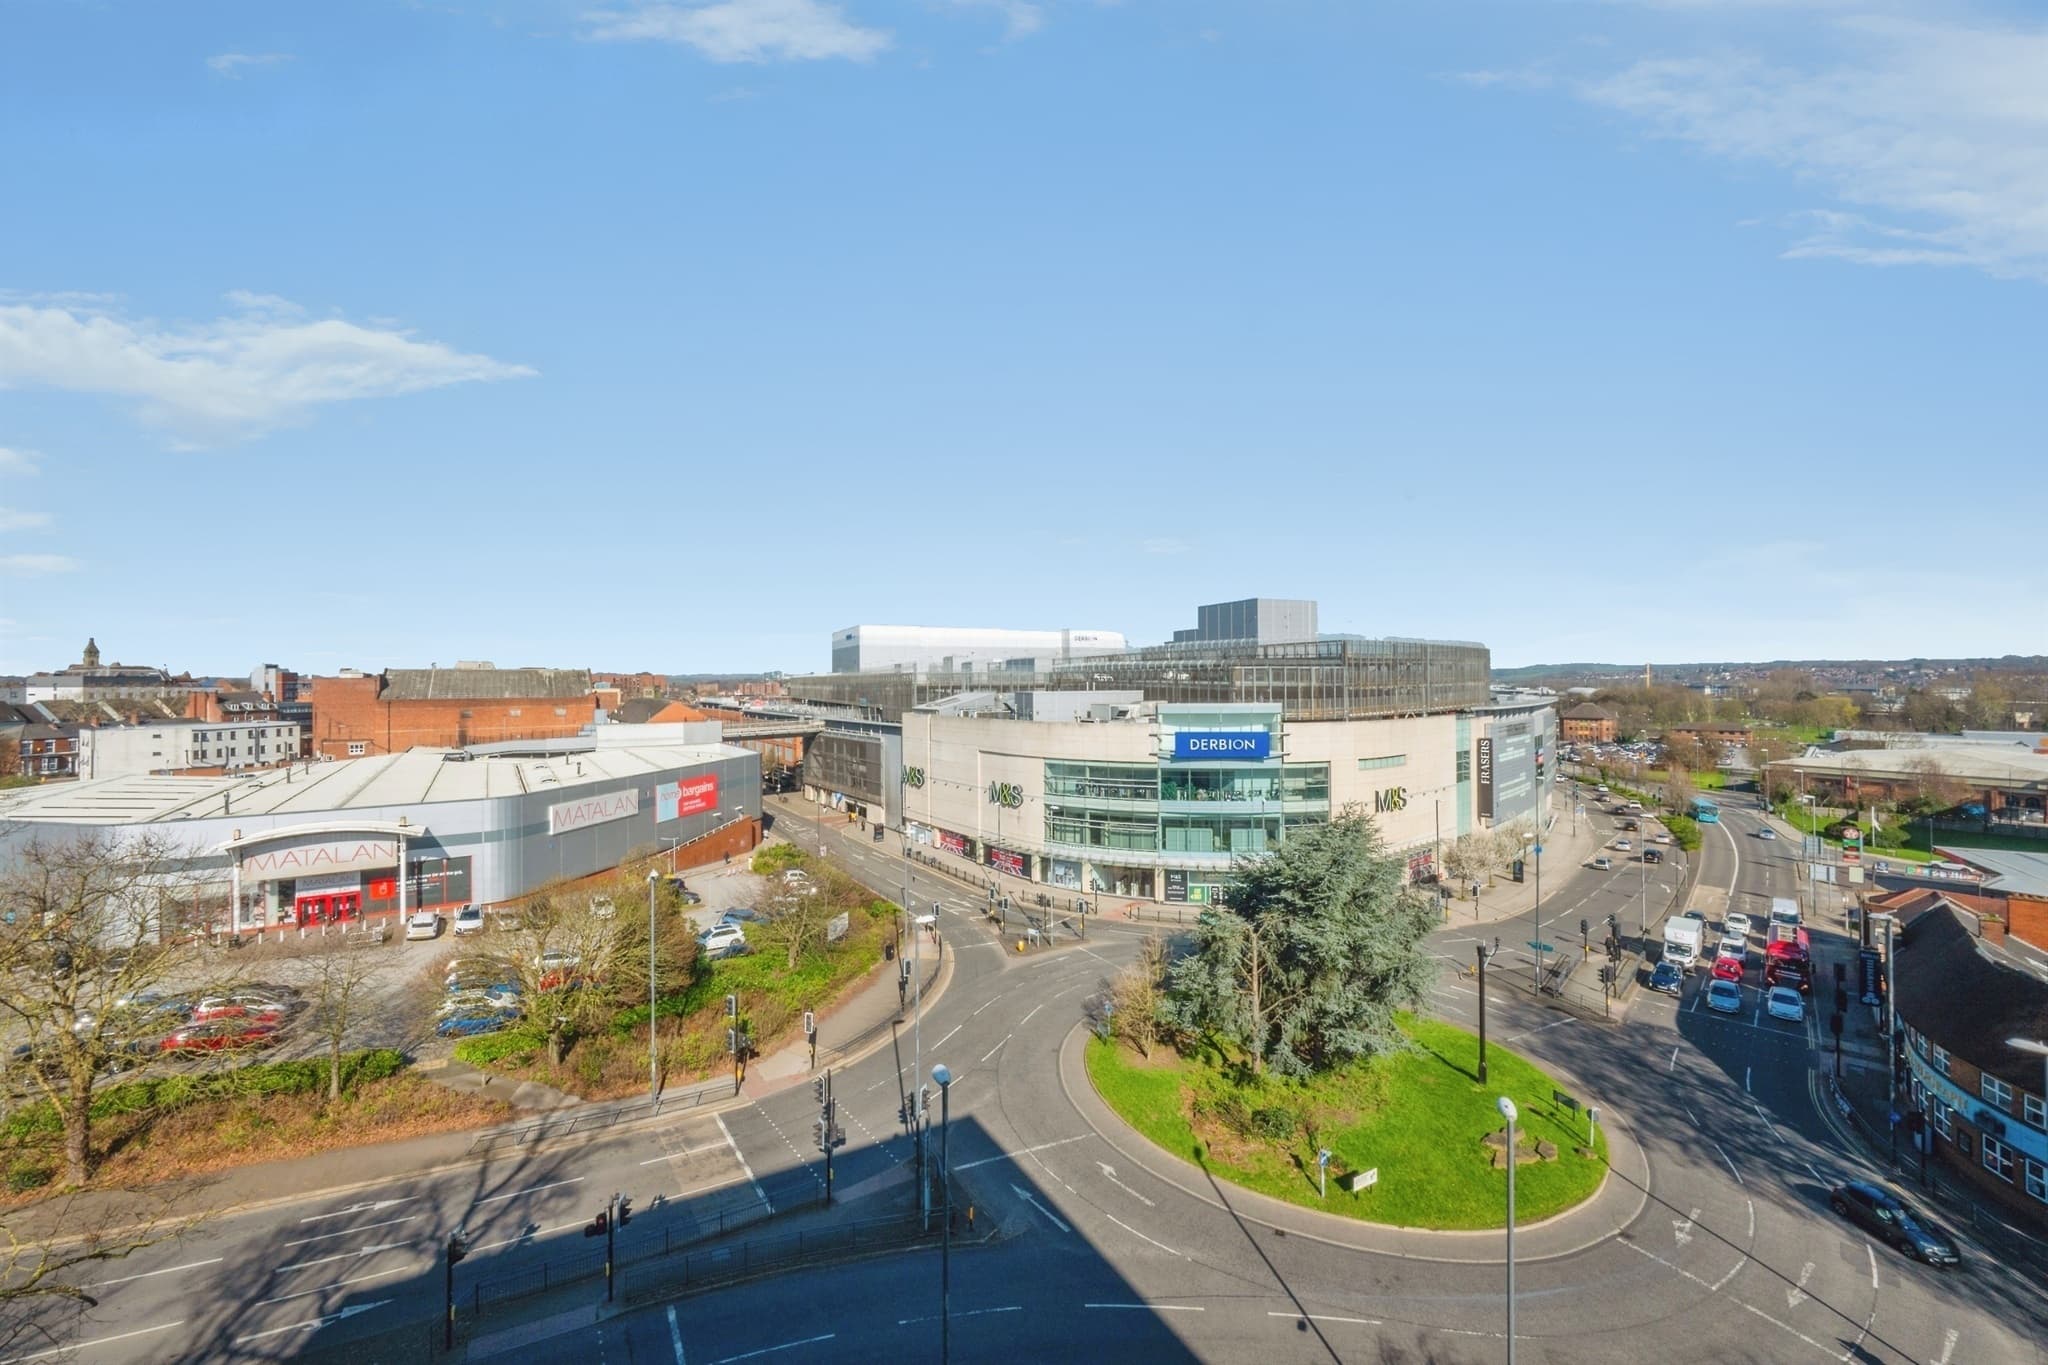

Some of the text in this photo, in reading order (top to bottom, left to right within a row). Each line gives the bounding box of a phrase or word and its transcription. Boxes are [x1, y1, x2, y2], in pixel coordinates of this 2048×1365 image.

[1190, 739, 1255, 750] DERBION
[1481, 739, 1490, 784] FRASERS
[682, 781, 714, 798] bargains
[901, 765, 925, 789] M&S
[989, 780, 1024, 809] M&S
[1375, 786, 1407, 813] M&S
[553, 795, 637, 830] MATALAN
[248, 842, 394, 872] MATALAN
